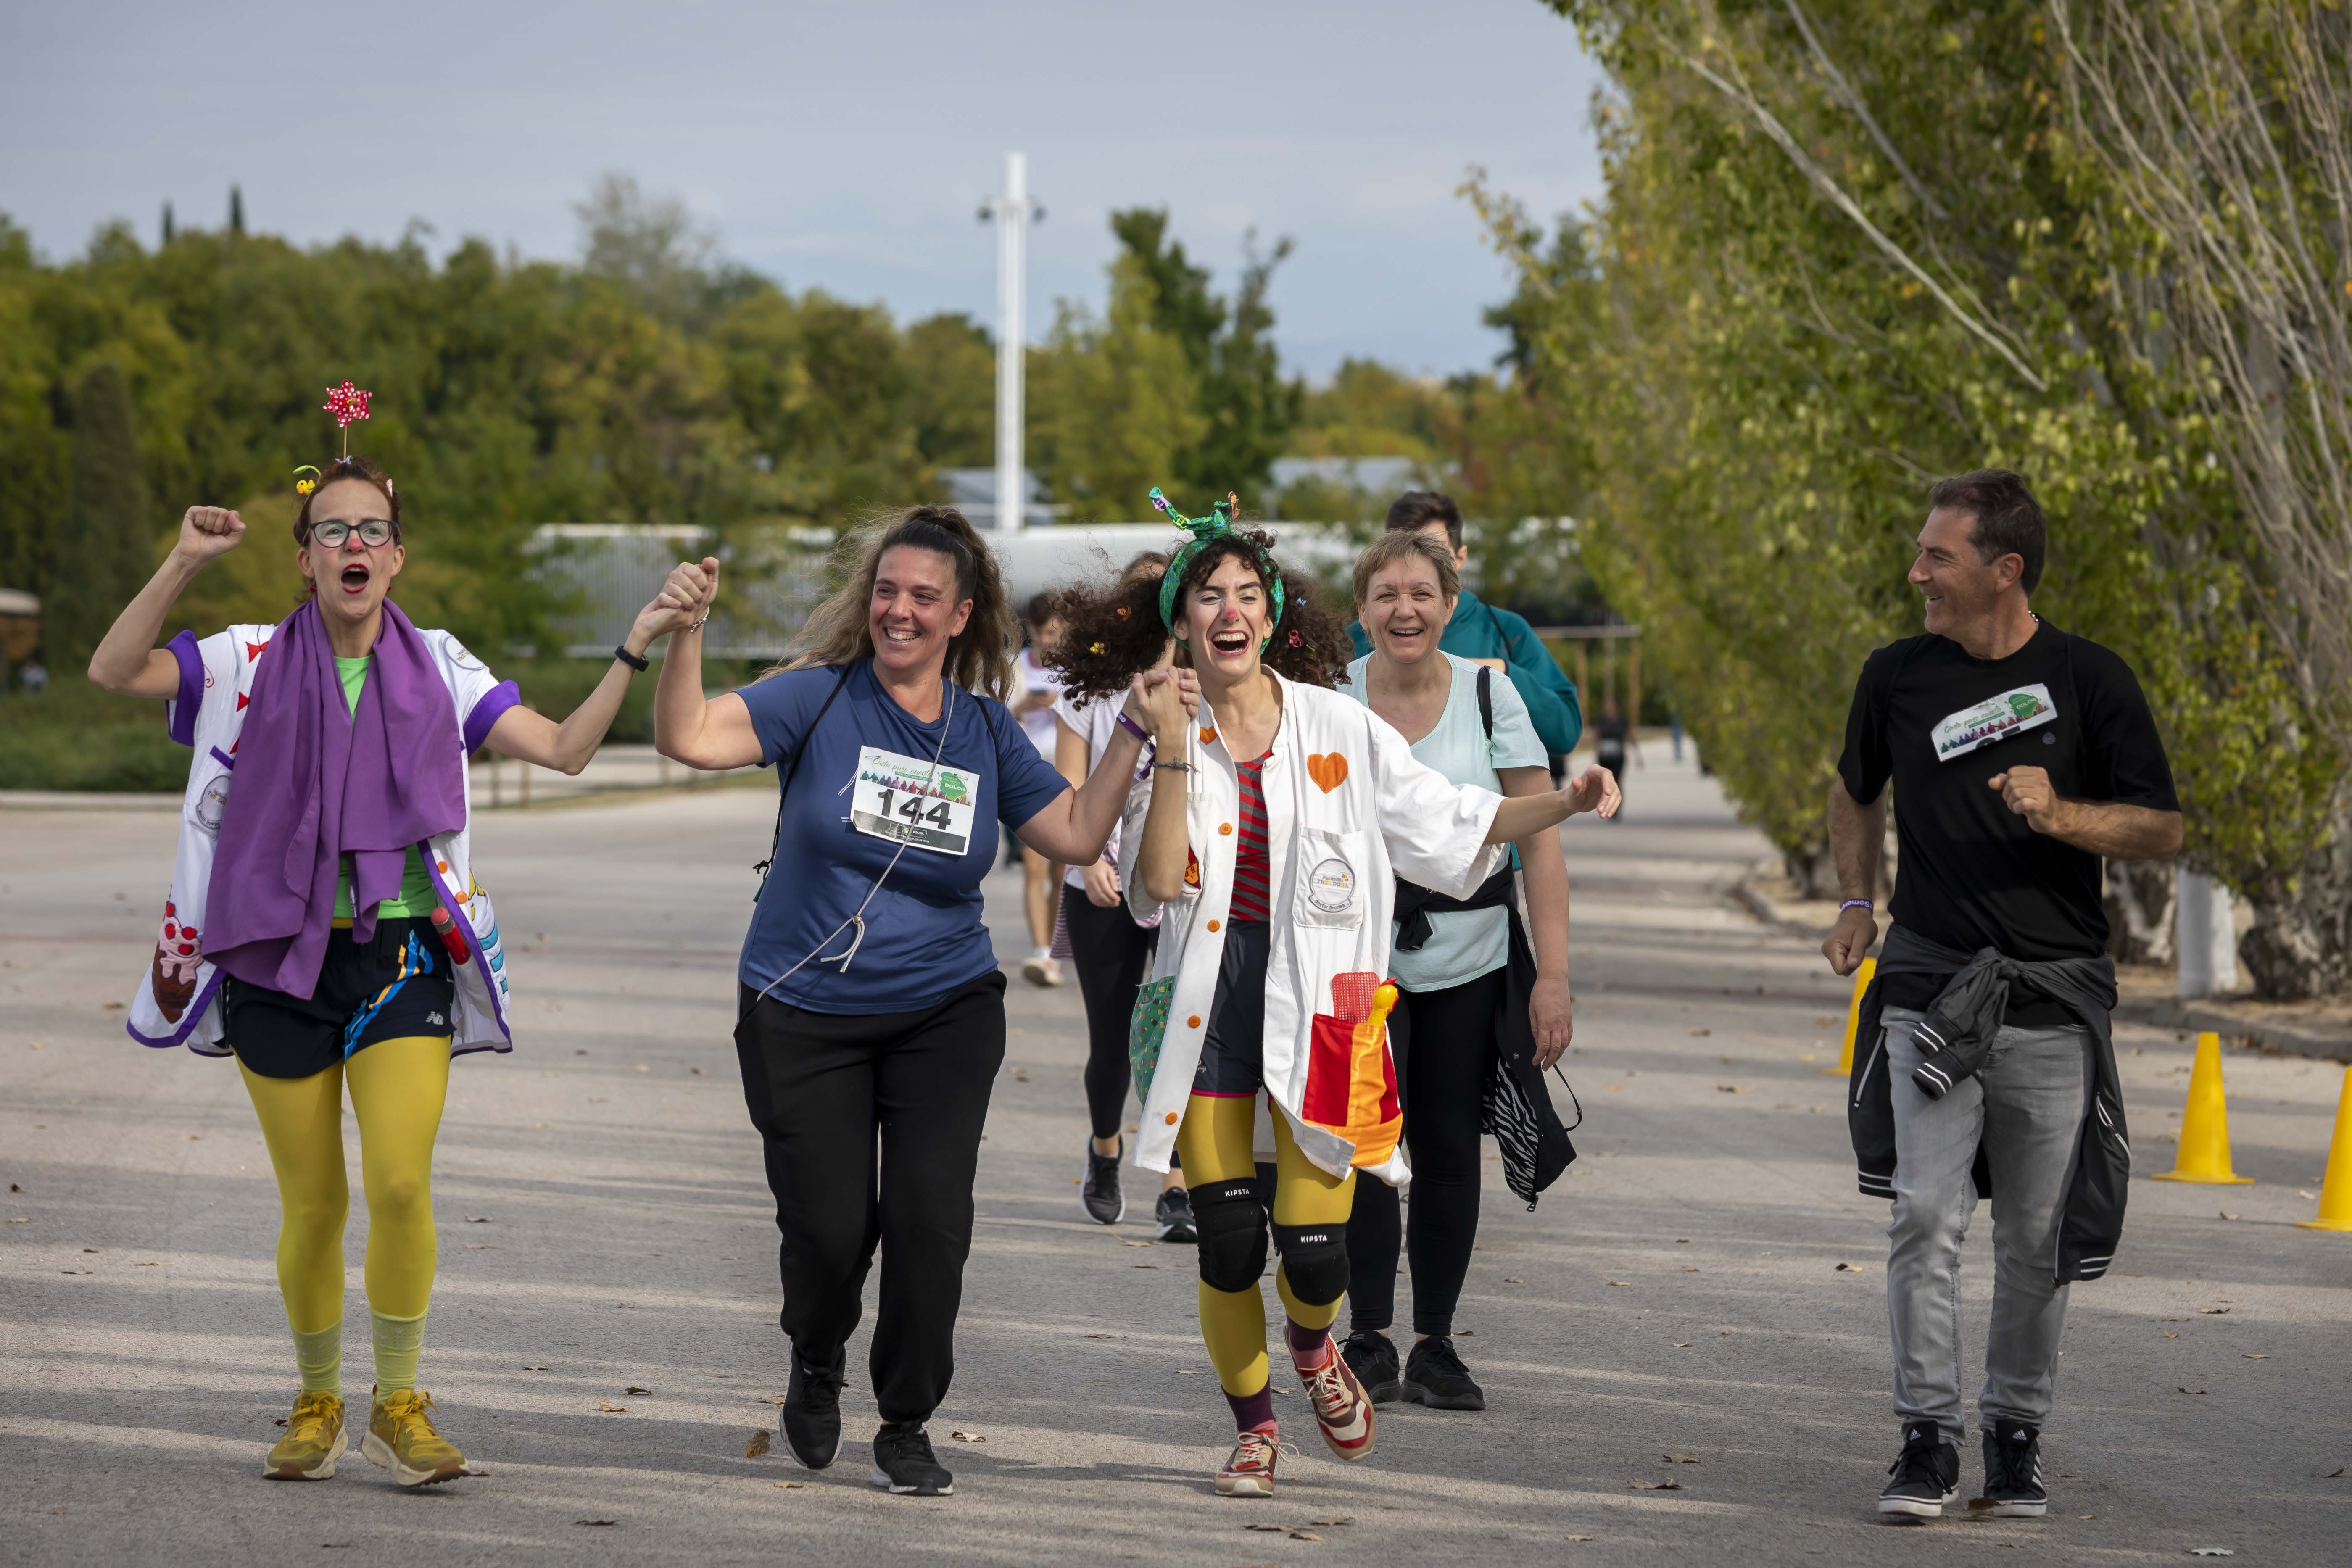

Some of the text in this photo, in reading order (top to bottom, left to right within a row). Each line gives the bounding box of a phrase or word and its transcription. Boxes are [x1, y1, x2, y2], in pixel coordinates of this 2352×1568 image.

[873, 757, 890, 768] Cada
[945, 783, 965, 791] DOLOR
[878, 789, 952, 830] 144
[1315, 900, 1328, 908] doctor
[1300, 1234, 1327, 1244] KIPSTA
